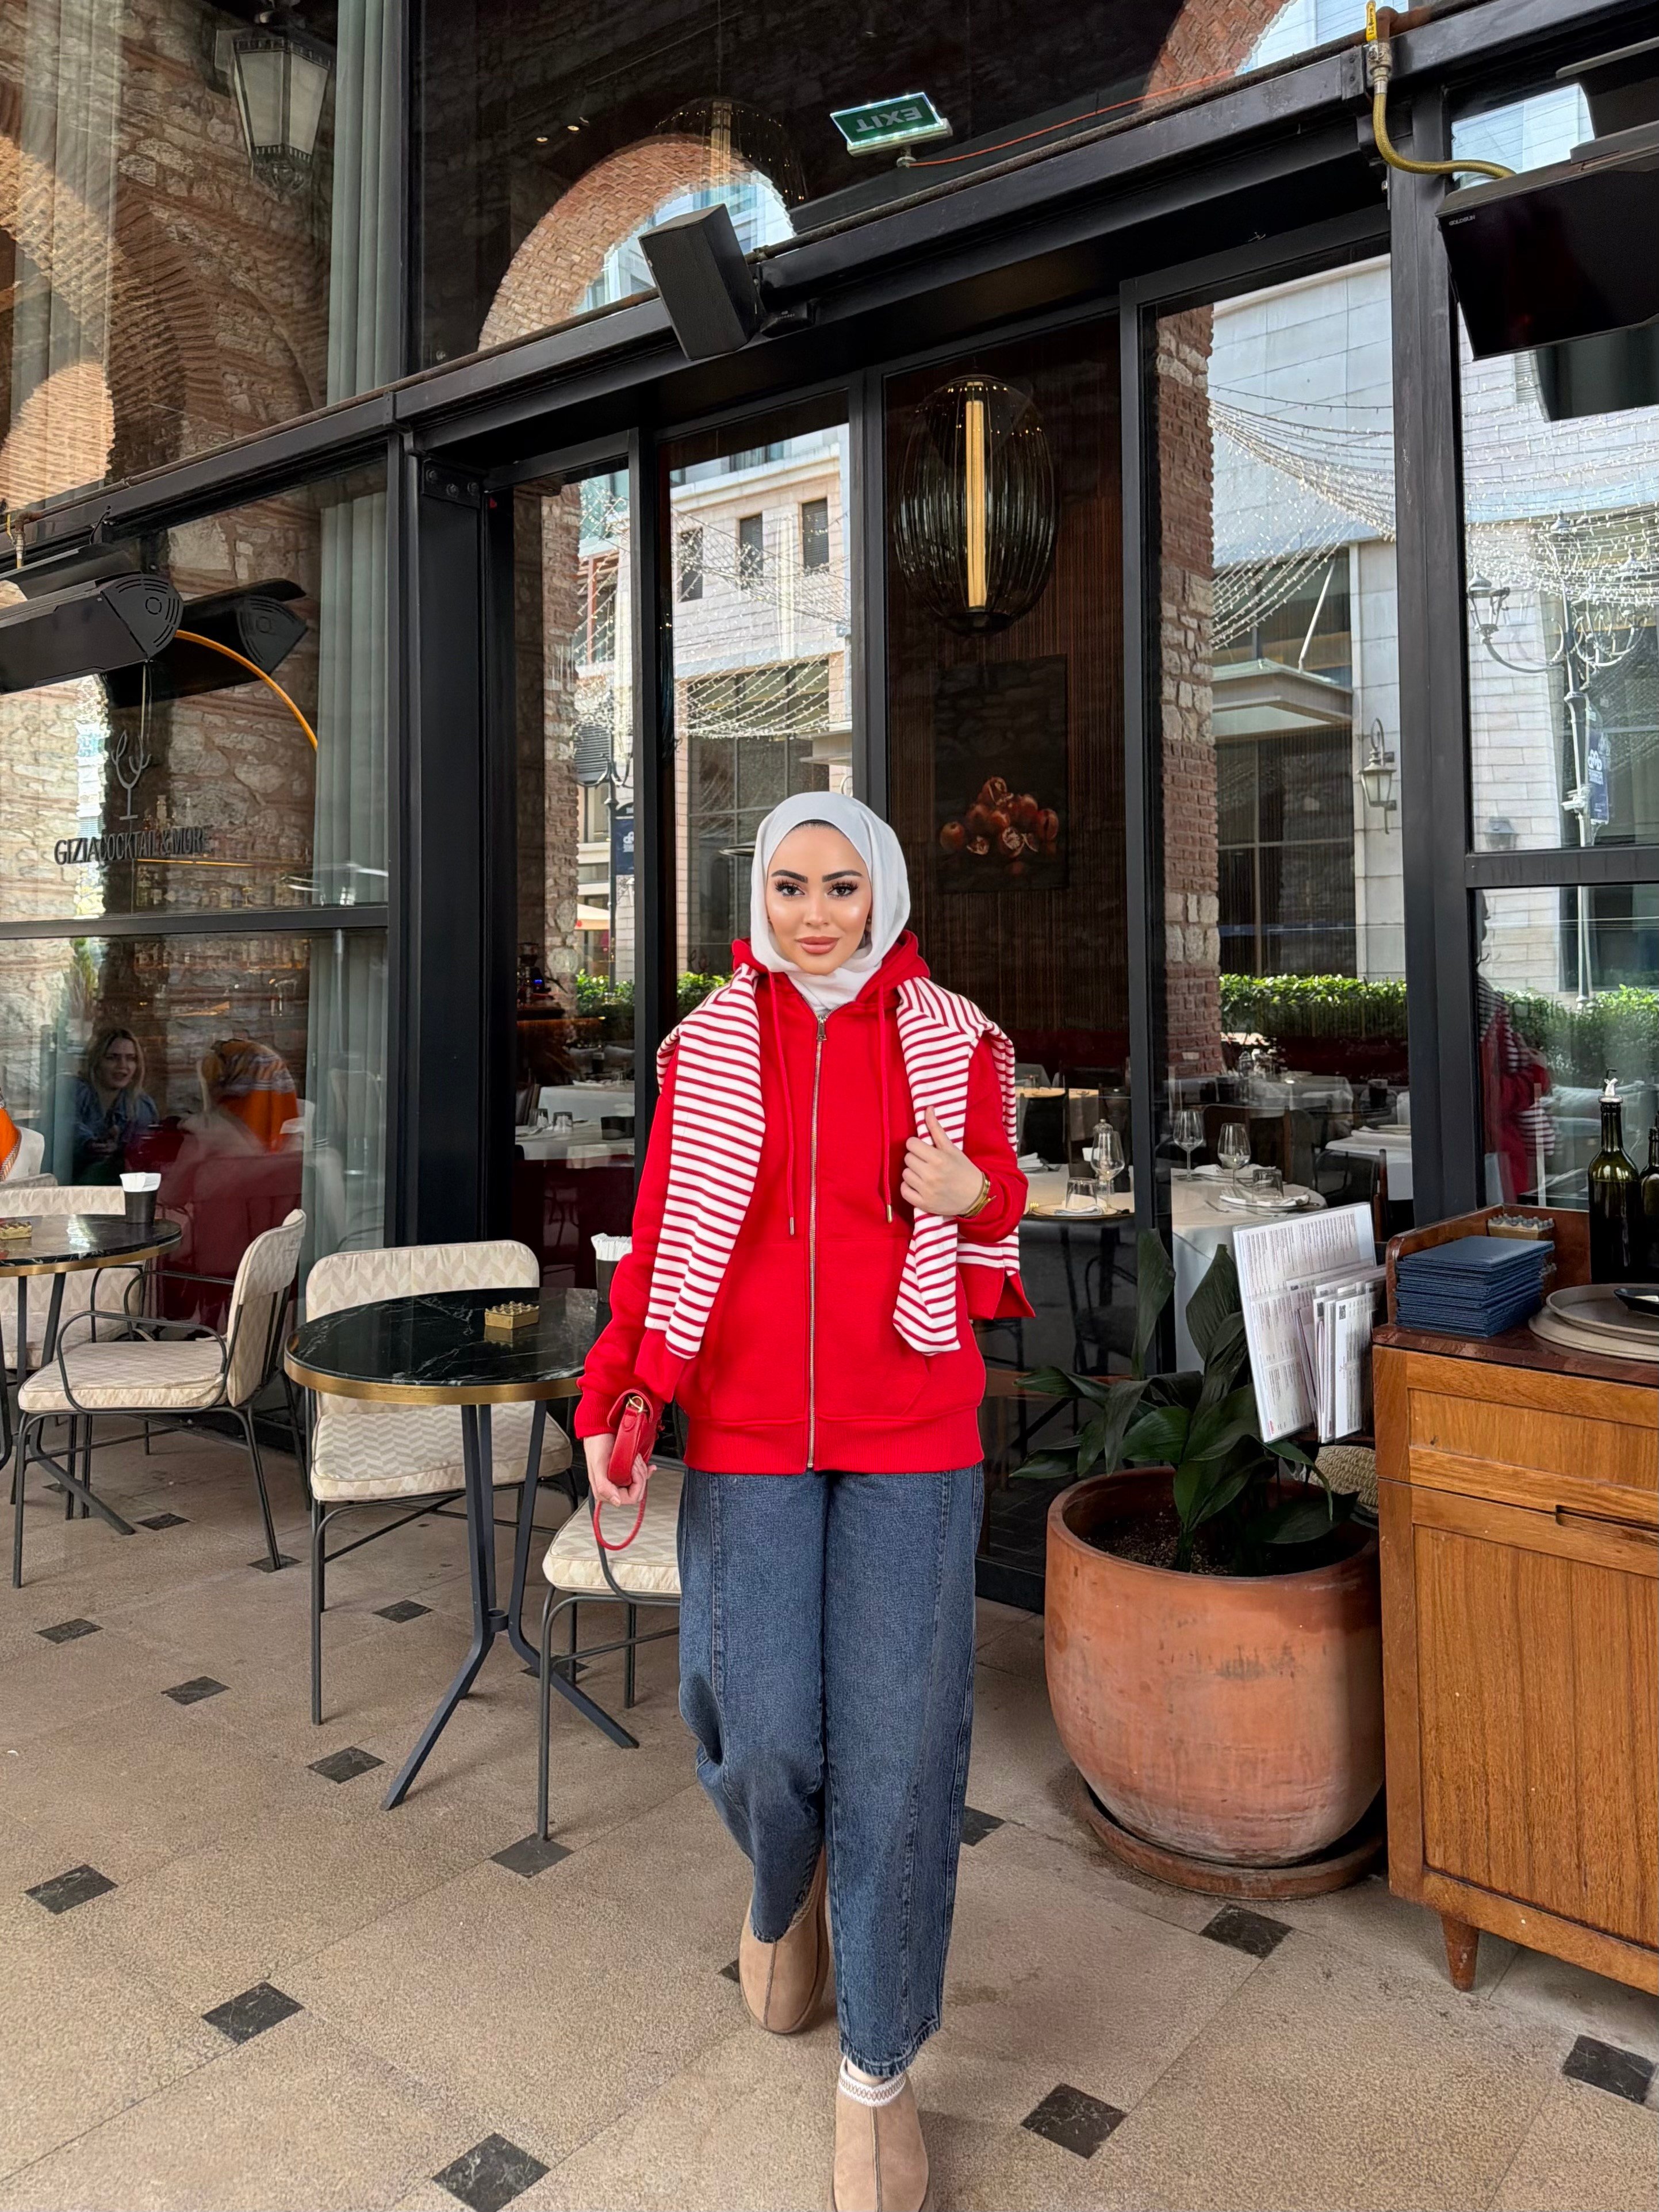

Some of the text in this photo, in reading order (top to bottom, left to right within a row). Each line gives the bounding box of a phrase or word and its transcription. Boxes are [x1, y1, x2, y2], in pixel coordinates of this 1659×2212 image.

[856, 106, 923, 132] EXIT
[54, 837, 100, 865] GIZIA
[99, 830, 159, 862] COCKTAIL
[160, 829, 171, 856] &
